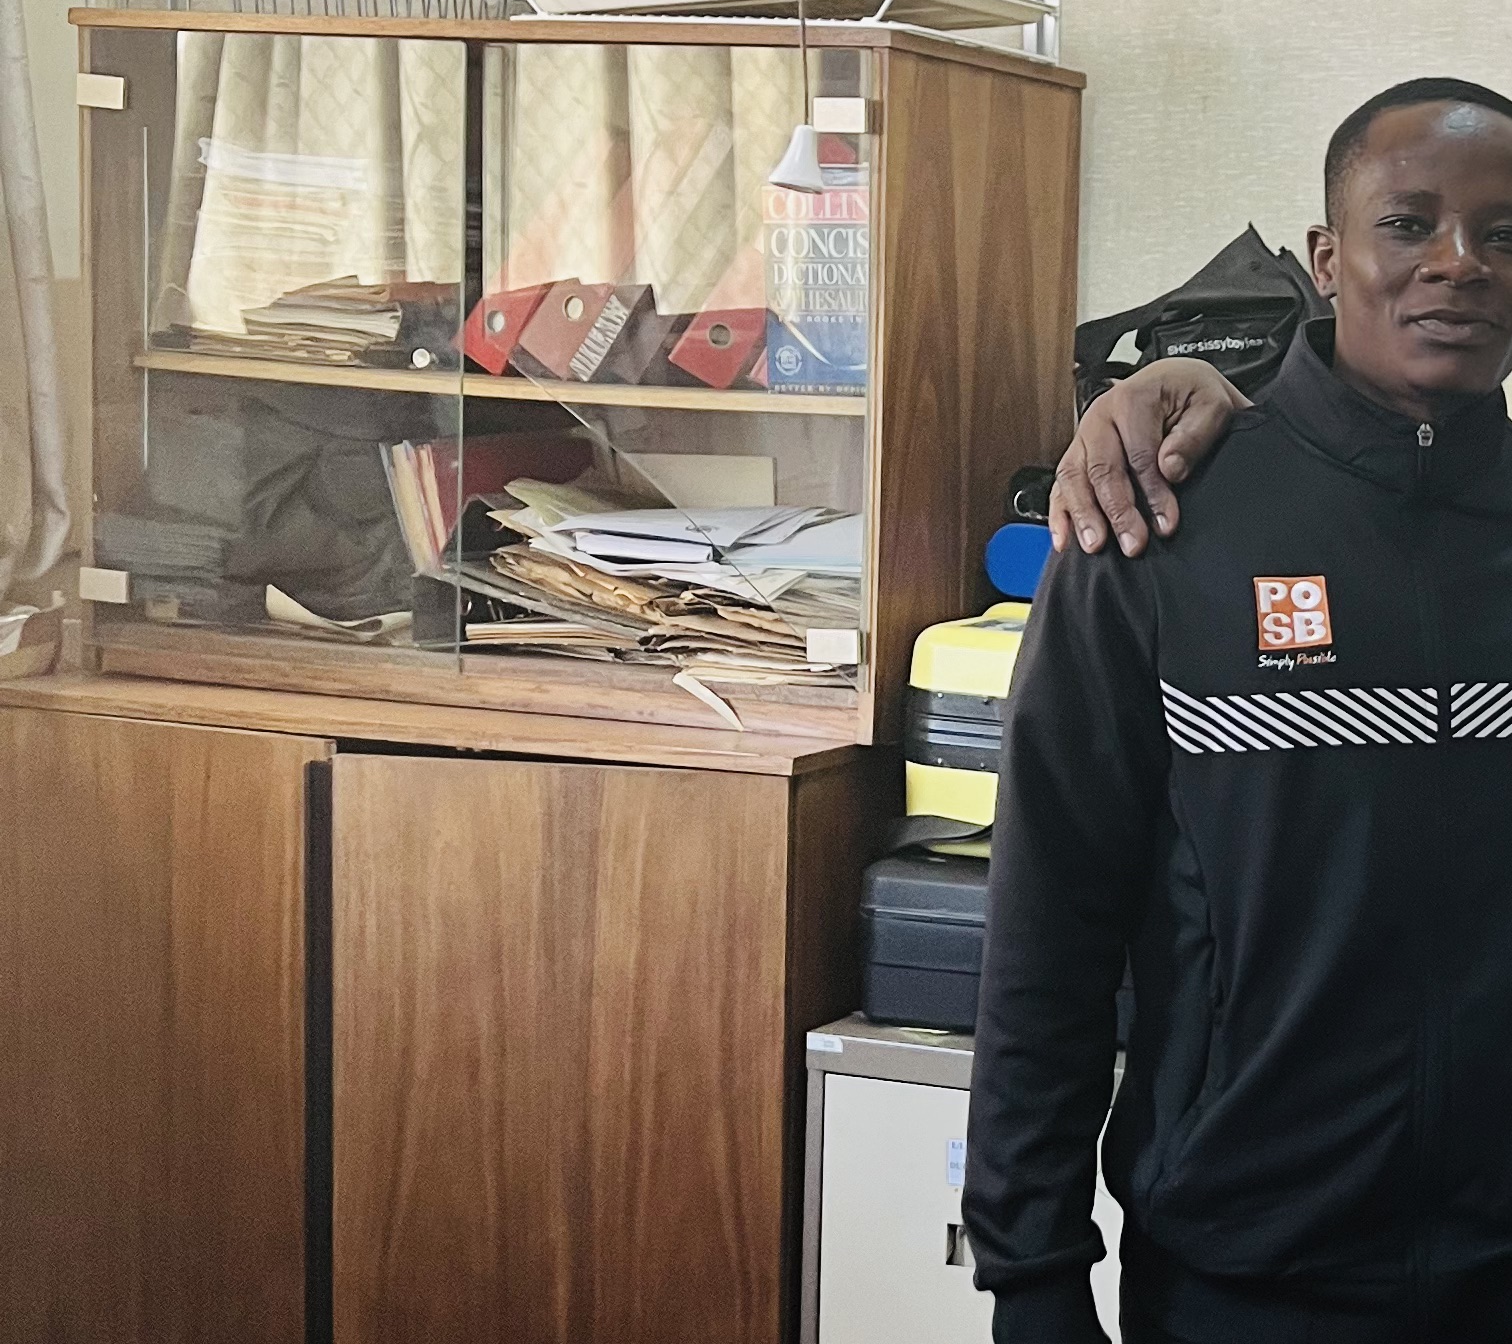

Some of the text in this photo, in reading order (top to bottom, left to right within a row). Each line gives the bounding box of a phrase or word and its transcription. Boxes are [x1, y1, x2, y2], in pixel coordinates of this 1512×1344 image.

[768, 191, 869, 220] COLLIN
[771, 227, 869, 258] CONCIS
[773, 263, 868, 286] DICTIONA
[1258, 581, 1322, 613] PO
[1262, 611, 1327, 645] SB
[1258, 650, 1337, 672] Simply Possible
